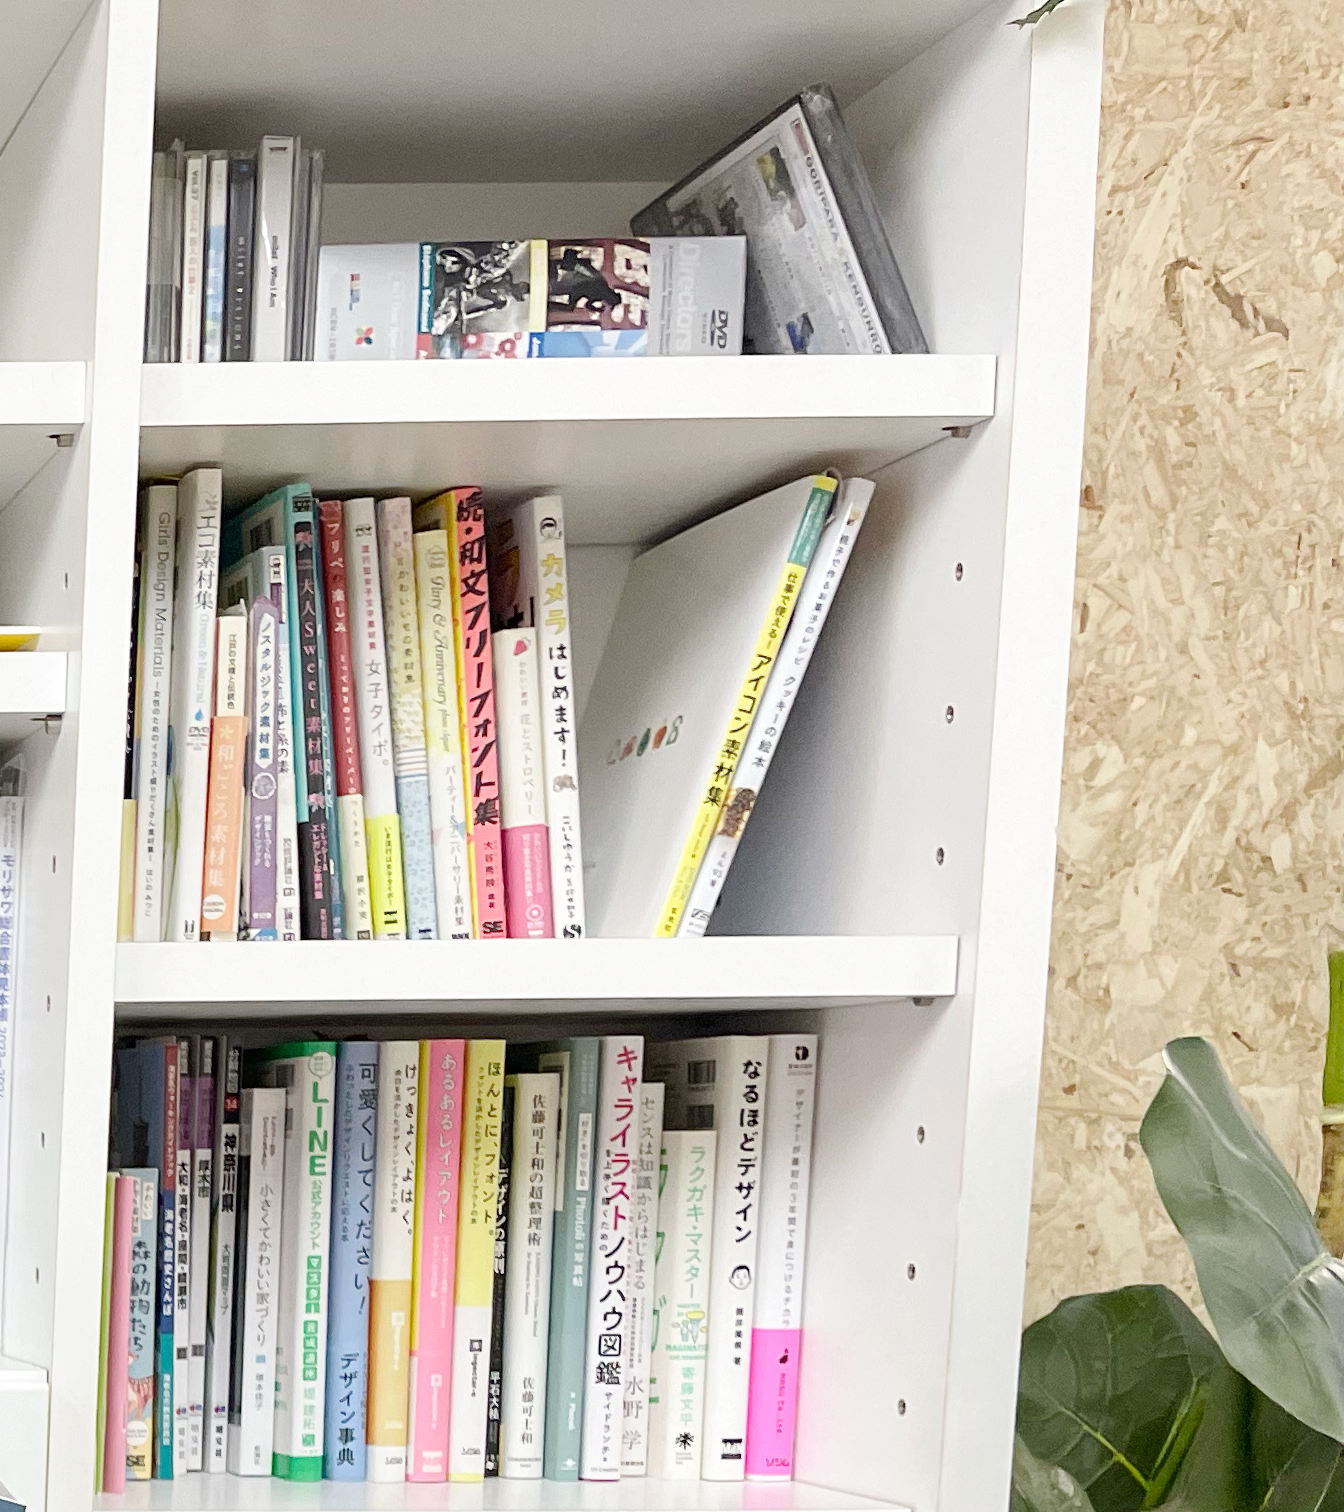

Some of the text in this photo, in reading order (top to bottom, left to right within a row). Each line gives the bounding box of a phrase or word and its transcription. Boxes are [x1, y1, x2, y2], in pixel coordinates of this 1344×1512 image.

[714, 308, 729, 350] DVD
[152, 549, 170, 679] Design Materials
[258, 621, 272, 760] ノスタルジック素材集
[456, 492, 500, 828] 続・和文フリーフォント集
[541, 551, 570, 767] カメラ はじめます!
[365, 660, 390, 767] 女子タイポ。
[703, 652, 772, 808] アイコン素材集
[750, 676, 795, 769] クッキーの絵本
[221, 1132, 237, 1213] 神奈川県
[308, 1080, 330, 1176] LINE
[401, 1064, 418, 1237] けっきょく、よはく。
[436, 1053, 456, 1225] あるあるレイアウト
[482, 1061, 502, 1237] ほんとに、フォント。
[527, 1094, 547, 1247] 佐藤可士和の超整理術
[634, 1096, 656, 1291] センスは知識からはじまる
[734, 1059, 763, 1244] なるほどデザイン
[336, 1062, 379, 1467] 可愛くしてください! デザイン事典
[596, 1045, 639, 1386] キャライラストノウハウ図鑑
[683, 1145, 707, 1299] ラクガキ・マスター
[521, 1376, 536, 1446] 佐藤可士和
